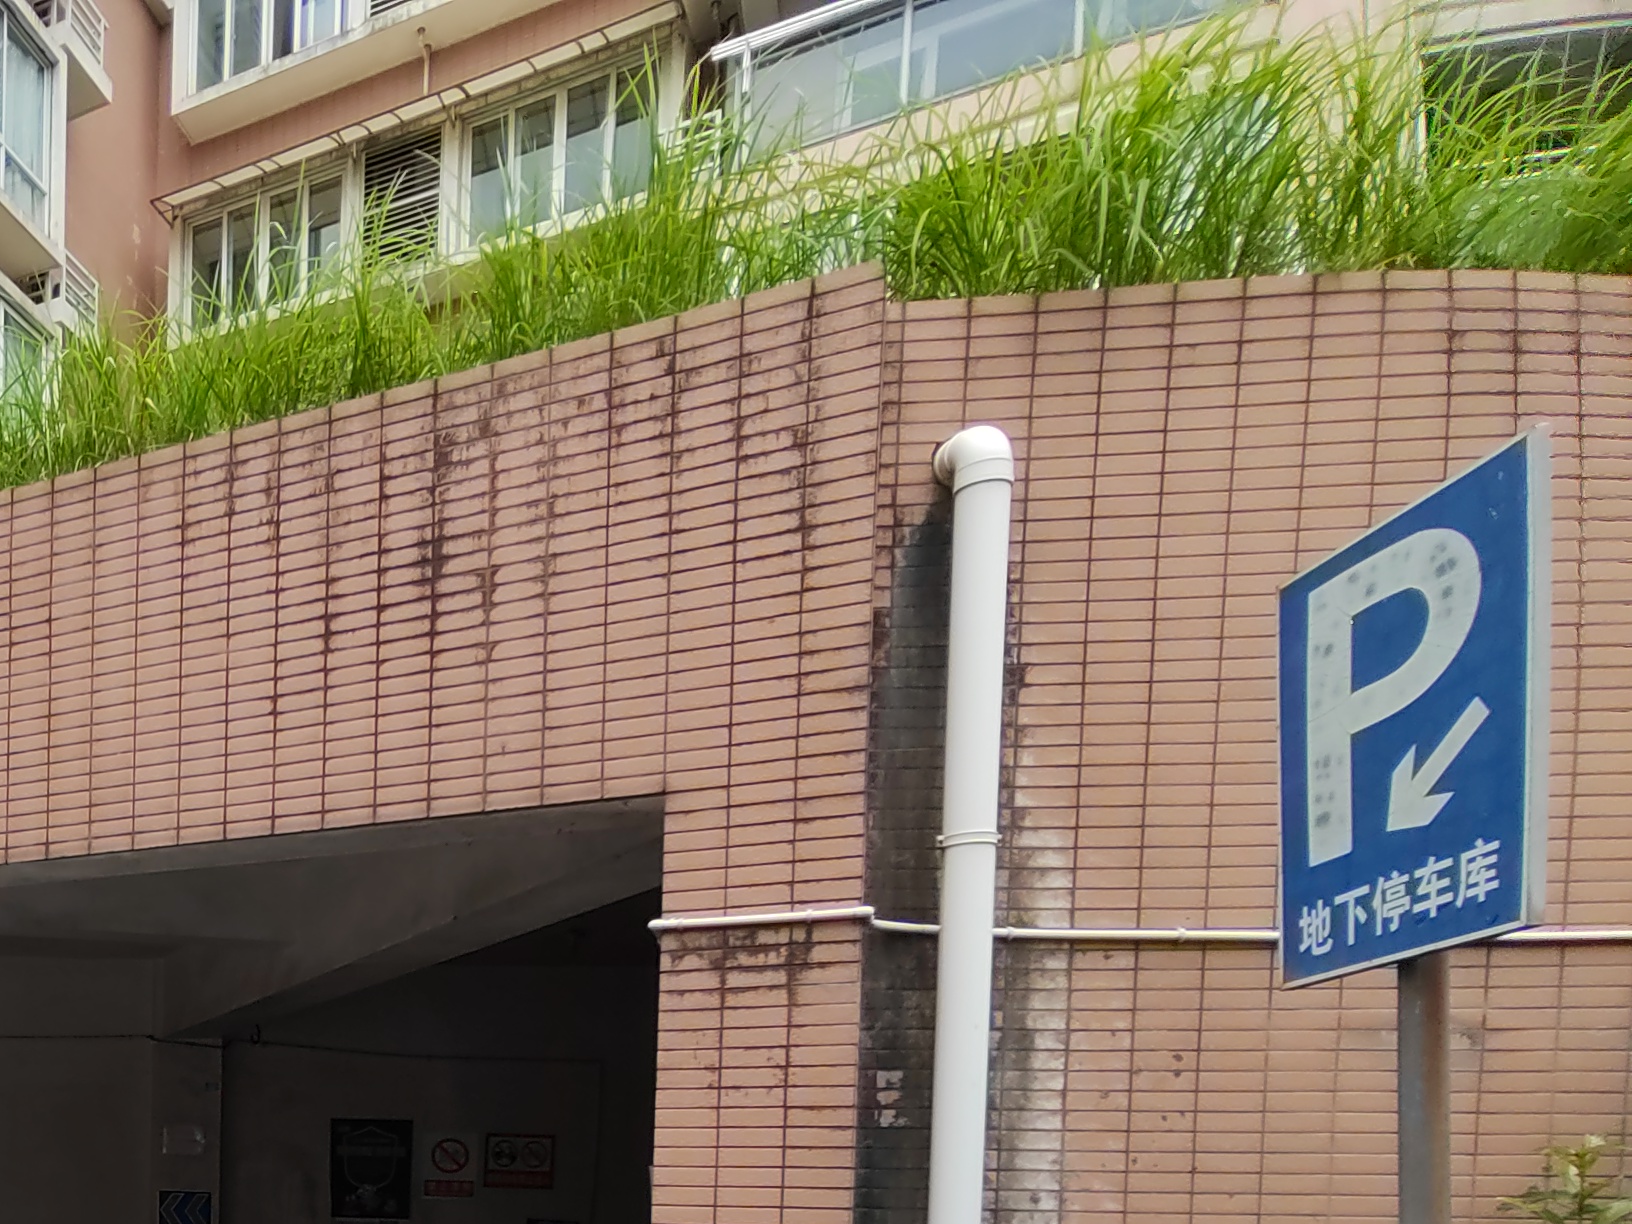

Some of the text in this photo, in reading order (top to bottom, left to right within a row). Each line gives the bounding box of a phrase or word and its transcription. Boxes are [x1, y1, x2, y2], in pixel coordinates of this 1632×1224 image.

[1308, 529, 1481, 866] P
[1299, 837, 1502, 957] 地下停车库
